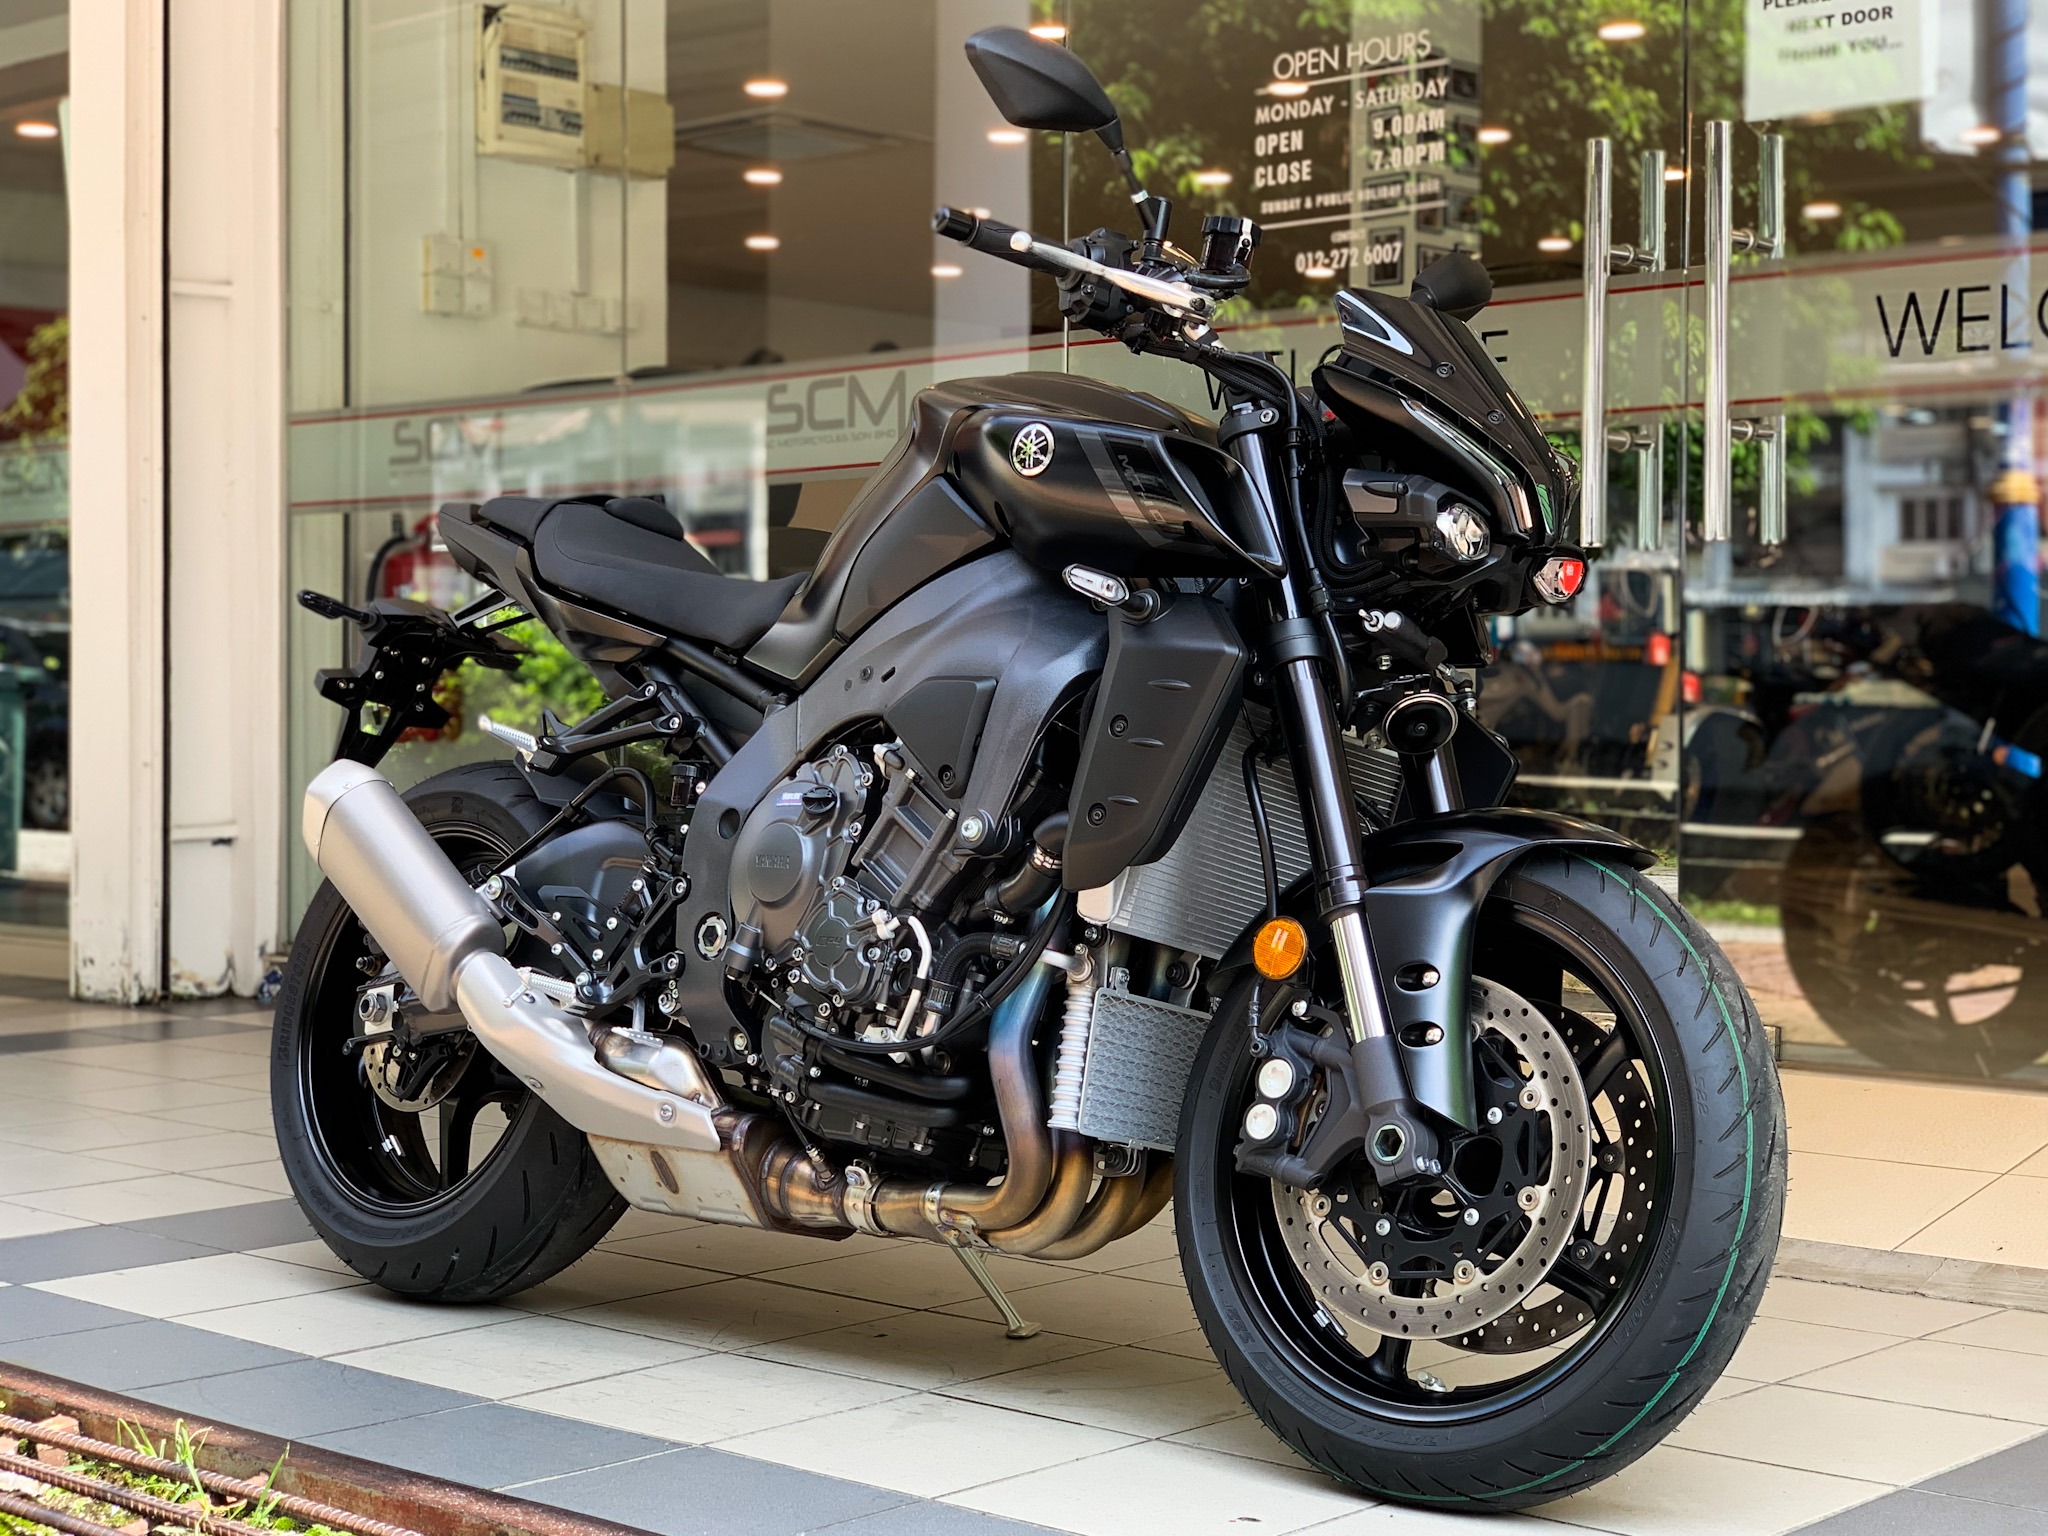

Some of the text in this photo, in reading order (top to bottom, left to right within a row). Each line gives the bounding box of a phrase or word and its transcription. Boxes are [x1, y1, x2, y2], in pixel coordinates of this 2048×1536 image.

[1842, 6, 1893, 26] DOOR
[1273, 29, 1431, 80] OPEN HOURS
[1255, 95, 1335, 125] MONDAY
[1355, 77, 1449, 109] SATURDAY
[1255, 109, 1446, 157] OPEN 9.00AM
[1255, 140, 1446, 188] CLOSE 7.00PM
[1260, 196, 1301, 215] SUNDAY
[1304, 195, 1313, 209] &
[1315, 190, 1353, 208] PUBLIC
[1295, 241, 1402, 274] 012-272 6007
[766, 370, 907, 442] SCM
